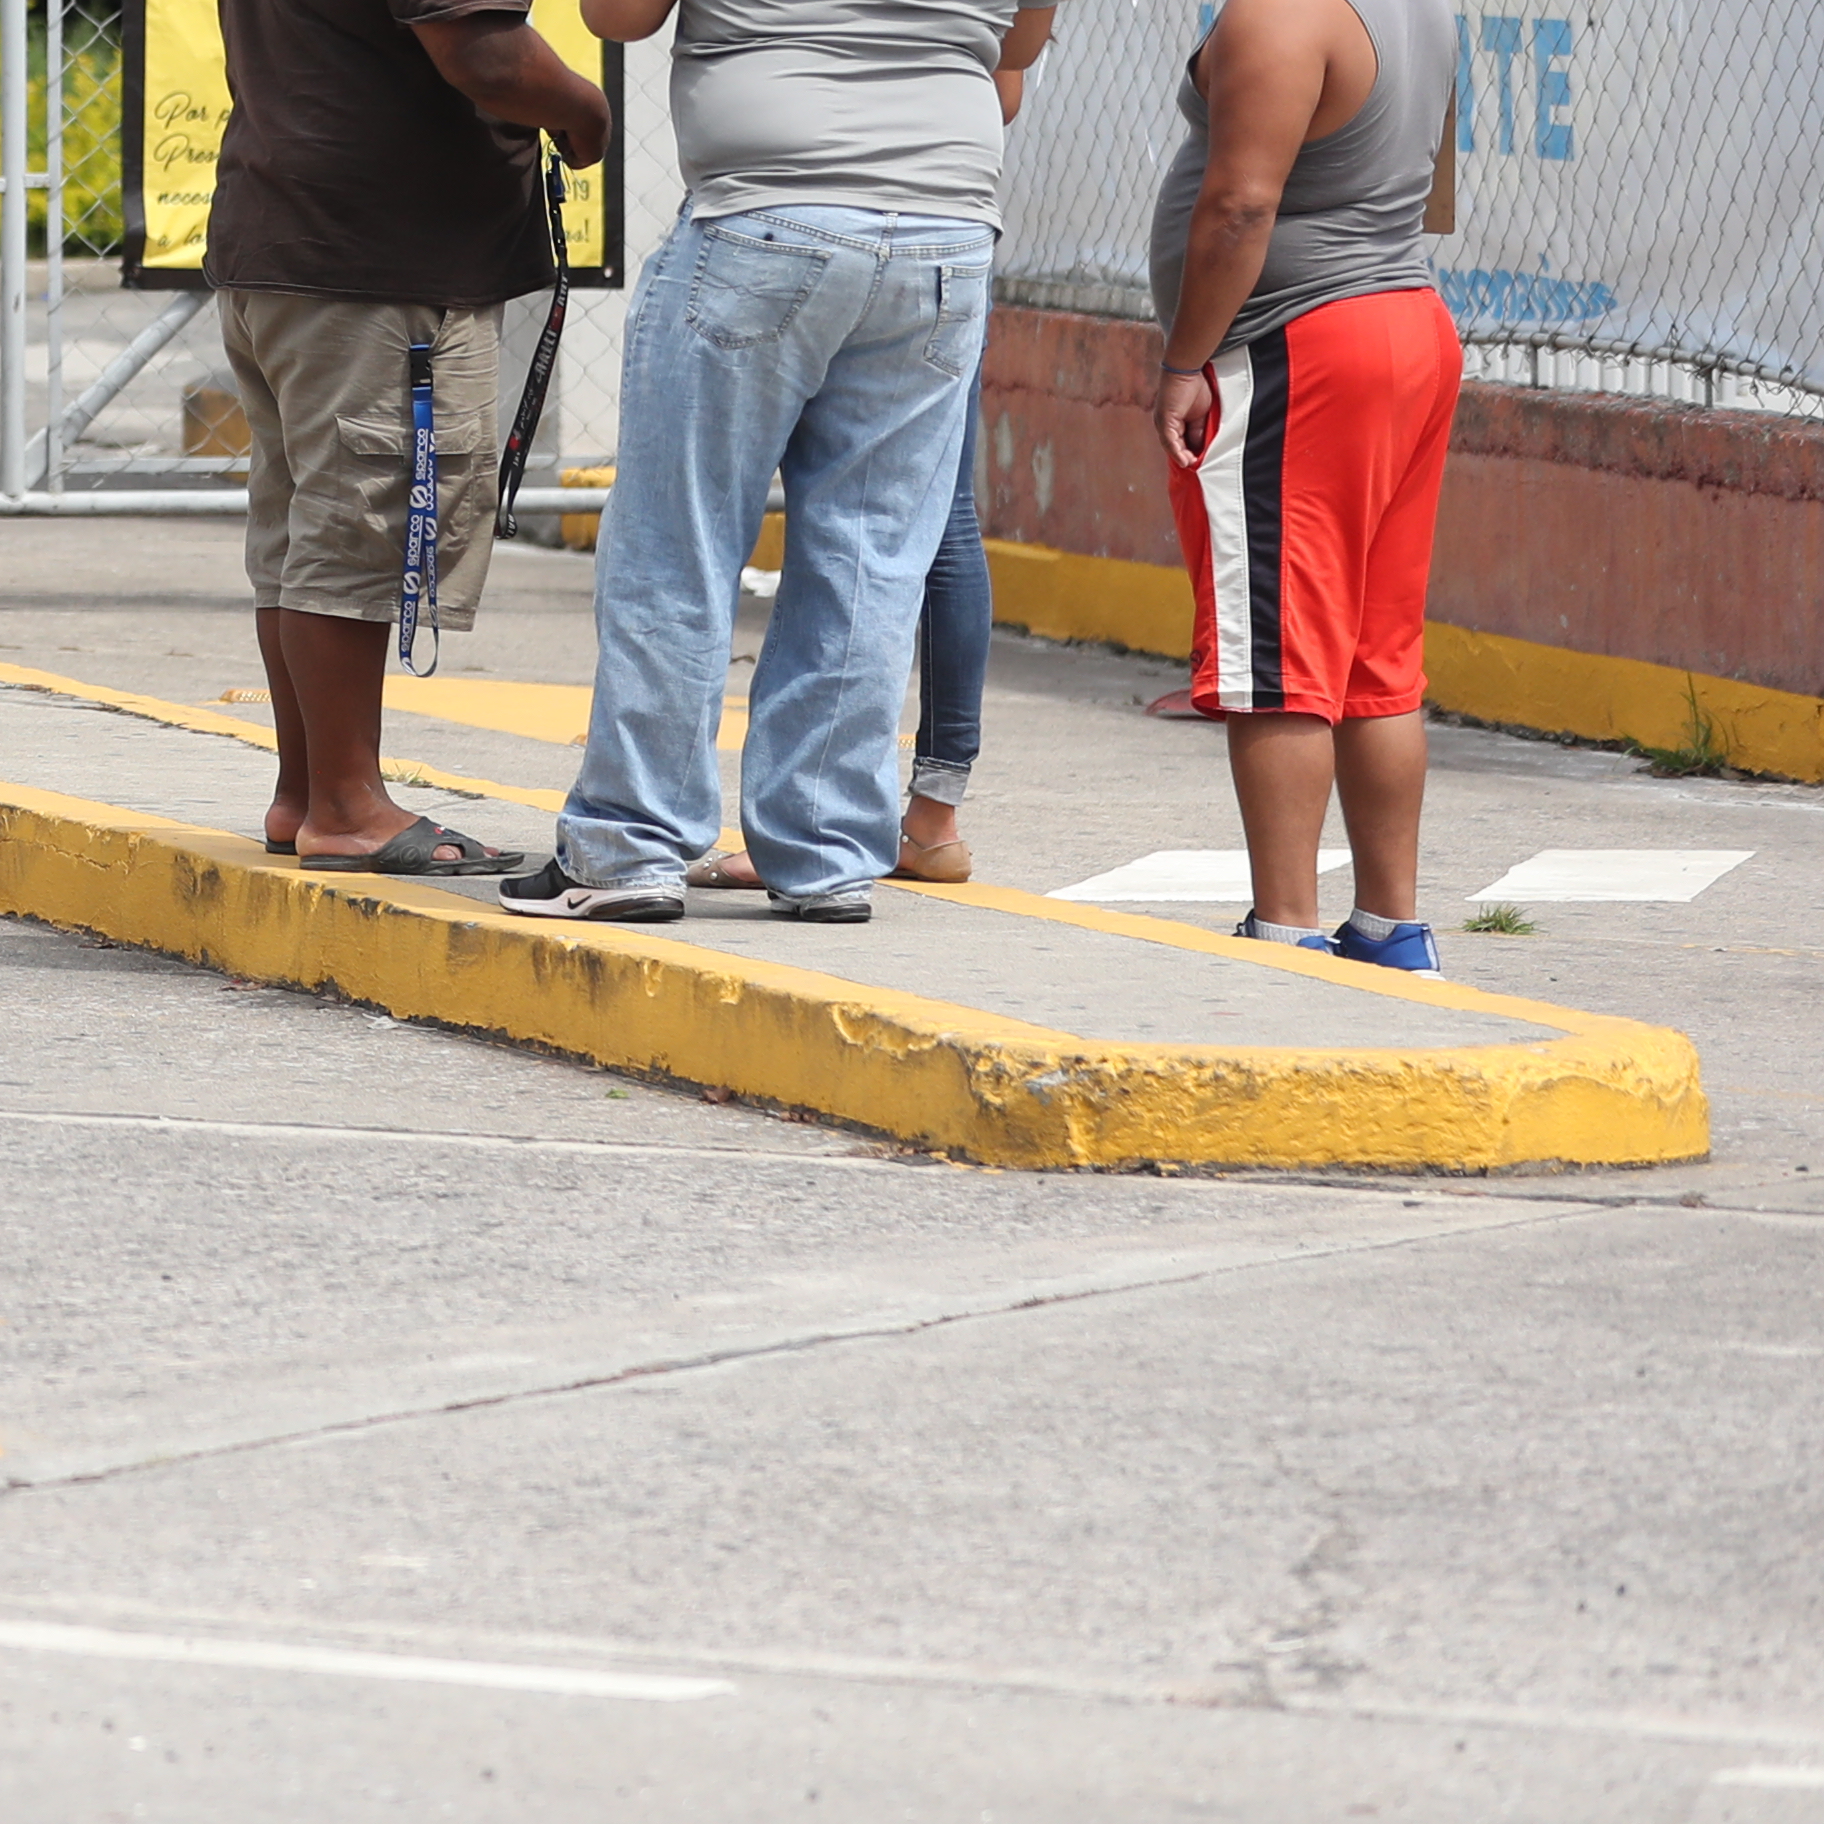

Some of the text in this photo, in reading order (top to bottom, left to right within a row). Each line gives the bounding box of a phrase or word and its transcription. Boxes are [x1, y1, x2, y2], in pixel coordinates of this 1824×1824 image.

[415, 428, 429, 481] sparco
[407, 514, 424, 567] sparco
[401, 600, 417, 653] sparco
